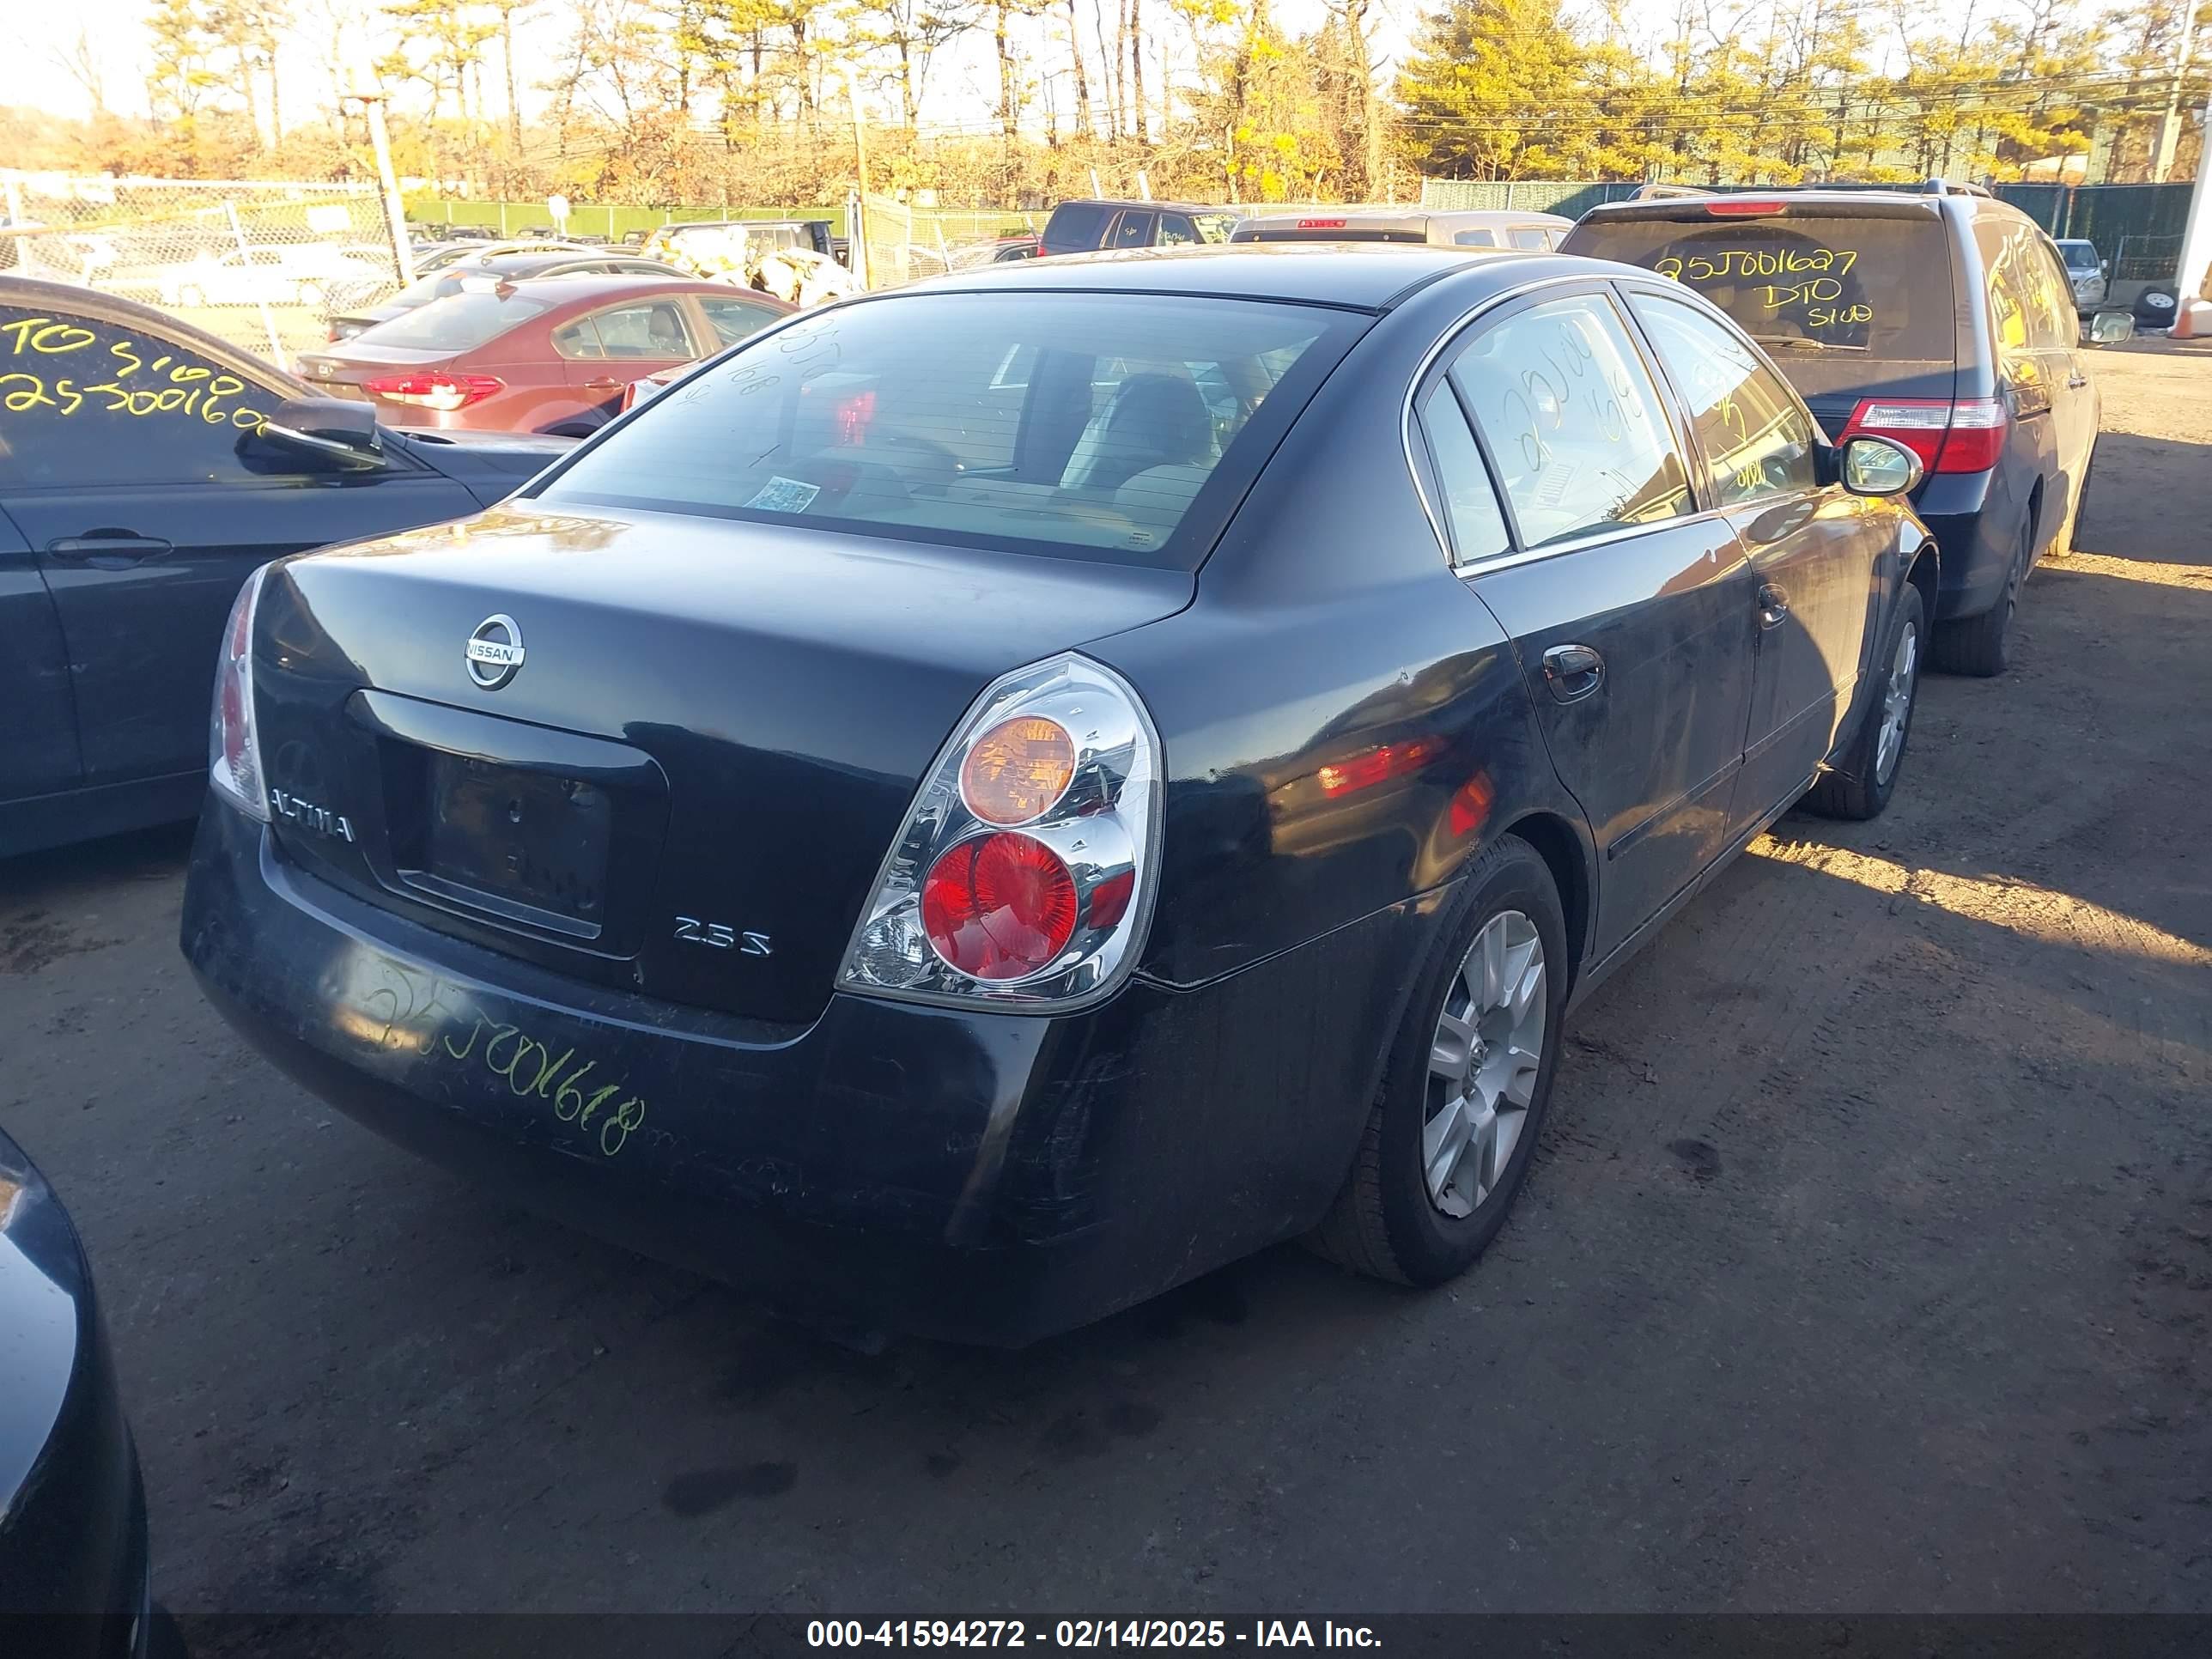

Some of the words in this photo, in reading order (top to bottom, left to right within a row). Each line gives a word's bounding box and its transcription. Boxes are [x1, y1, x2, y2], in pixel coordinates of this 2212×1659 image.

[1655, 249, 1858, 282] 25J001627
[1753, 278, 1842, 307] DTO
[2, 319, 95, 354] TO
[467, 643, 514, 661] NISSAN
[271, 788, 356, 842] ALTIMA
[740, 932, 773, 957] S
